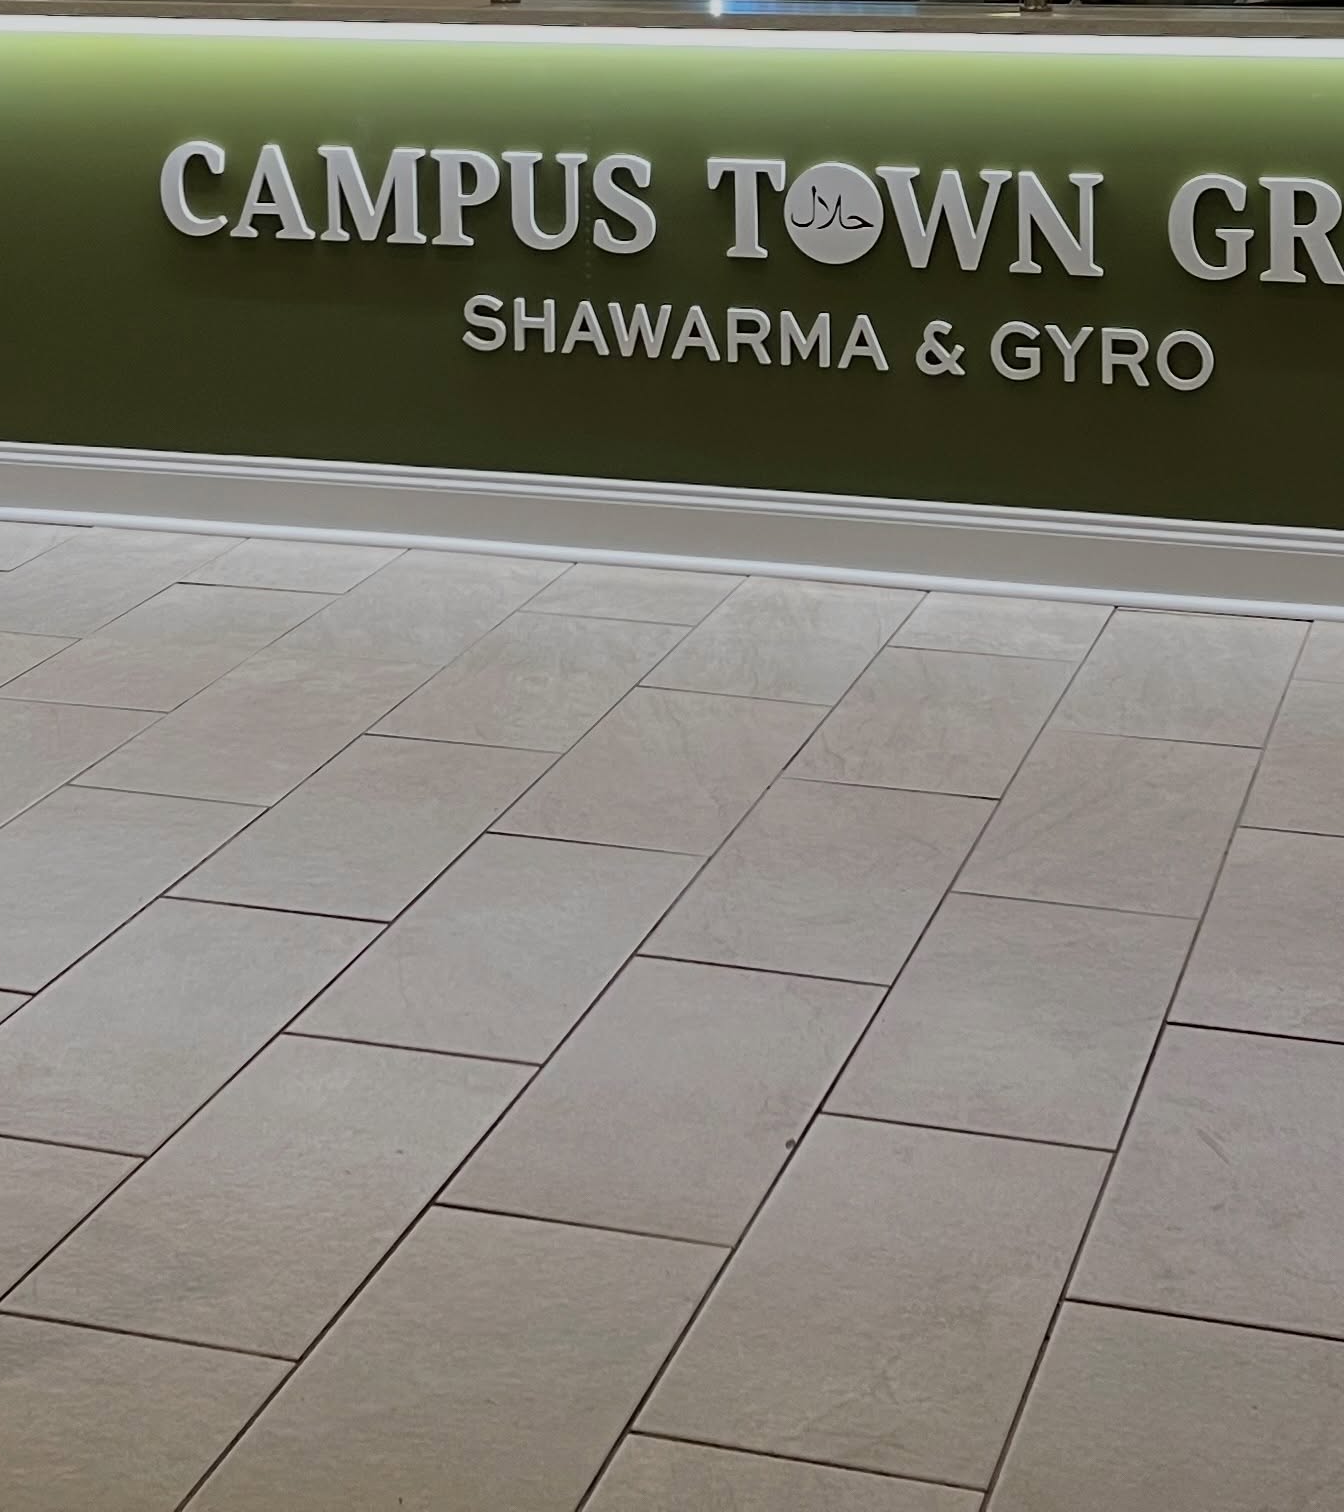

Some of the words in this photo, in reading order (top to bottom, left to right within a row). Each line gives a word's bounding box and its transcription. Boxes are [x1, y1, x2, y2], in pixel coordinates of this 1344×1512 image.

[161, 138, 657, 255] CAMPUS
[790, 185, 875, 230] حلال
[463, 294, 889, 371] SHAWARMA
[916, 320, 966, 376] &
[991, 320, 1215, 391] GYRO
